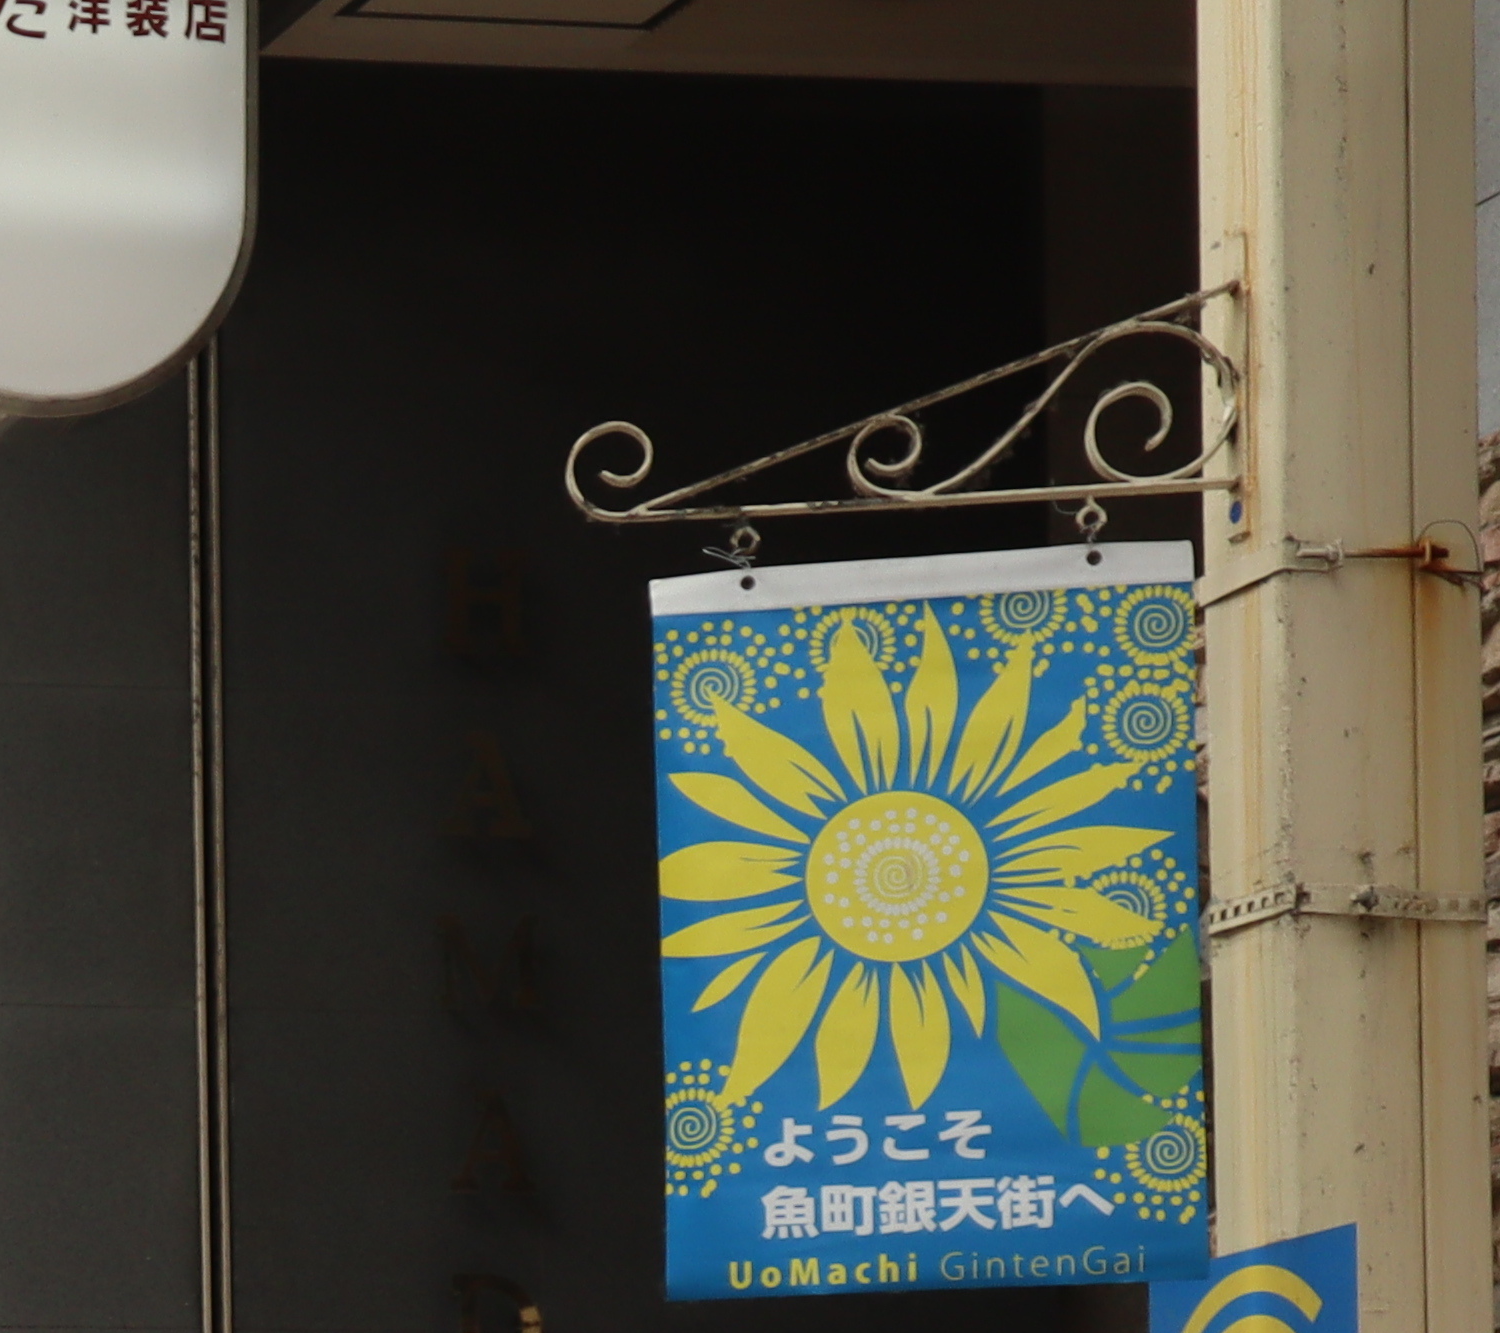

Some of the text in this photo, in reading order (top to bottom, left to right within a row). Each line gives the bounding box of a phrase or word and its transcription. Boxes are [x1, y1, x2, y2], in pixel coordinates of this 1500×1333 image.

[761, 1109, 993, 1169] ようこそ
[760, 1174, 1117, 1241] 魚町銀天街へ
[728, 1244, 1148, 1291] UoMachi GintenGai
